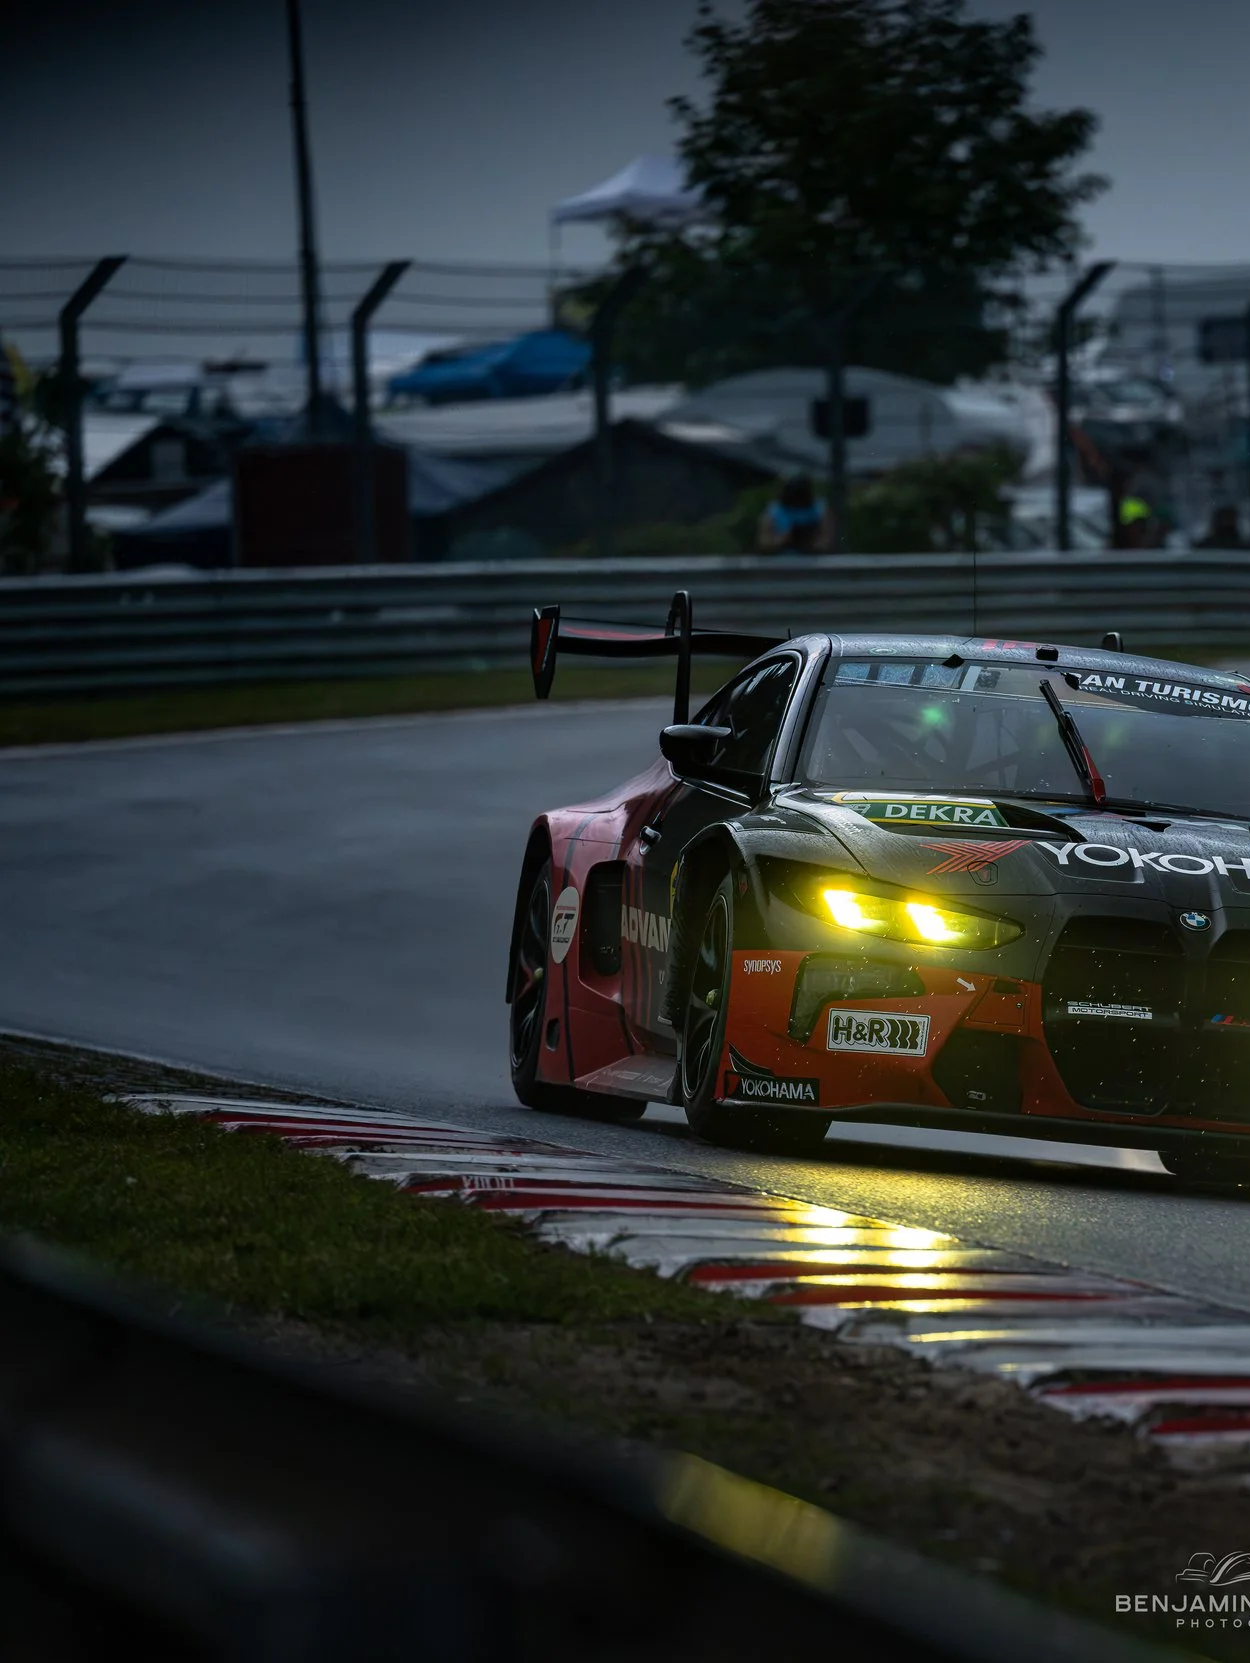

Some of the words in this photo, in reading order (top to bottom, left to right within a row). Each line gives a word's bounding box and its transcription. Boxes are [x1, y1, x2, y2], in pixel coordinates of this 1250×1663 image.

[1065, 672, 1126, 690] AN
[1079, 686, 1117, 695] REAL
[1121, 690, 1181, 703] DRIVING
[884, 804, 998, 826] DEKRA
[621, 904, 671, 953] ADVAN
[1067, 1000, 1153, 1012] SCHUBERT
[1071, 1006, 1149, 1018] MOTORSPORT
[832, 1014, 889, 1048] H&R
[741, 1078, 815, 1101] YOKOHAMA
